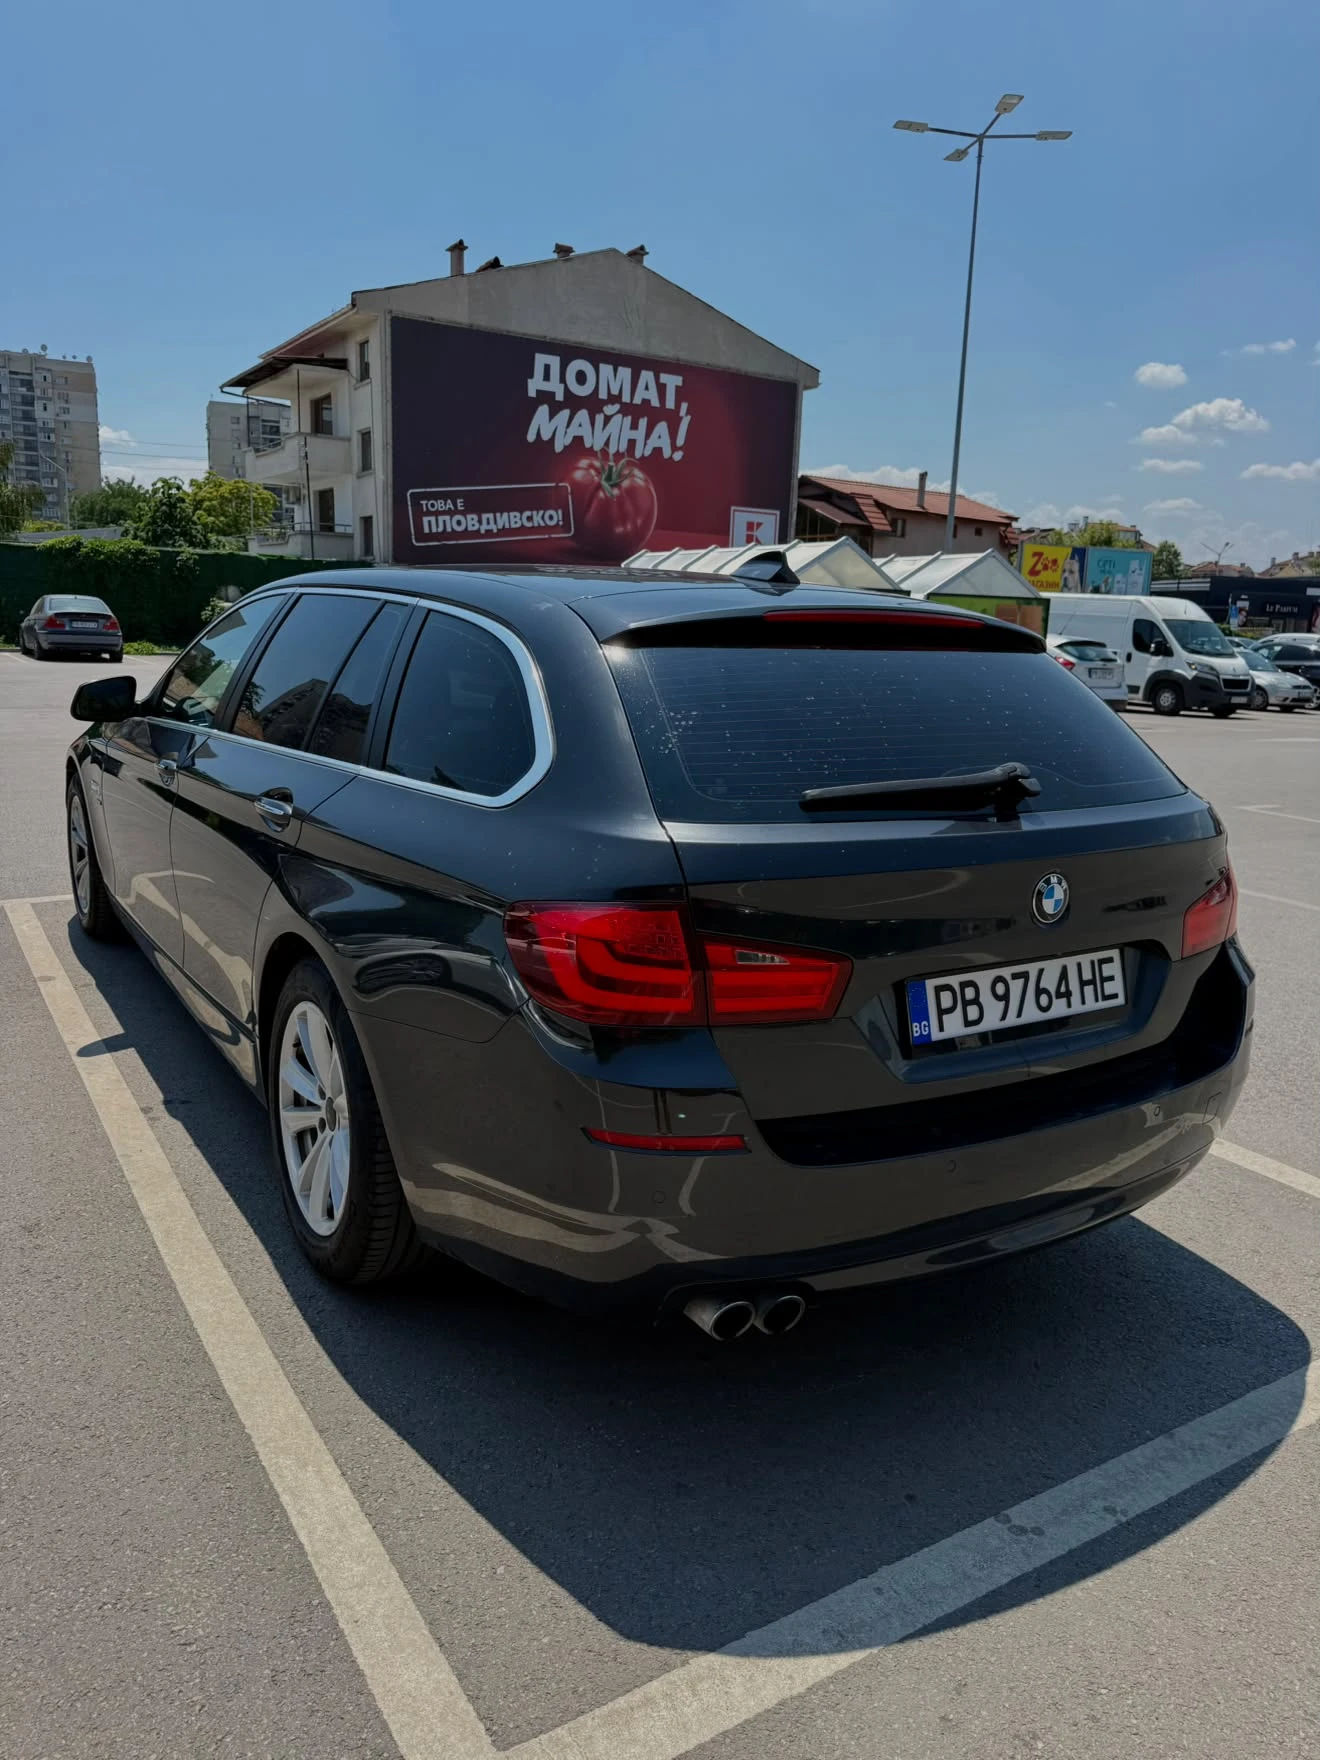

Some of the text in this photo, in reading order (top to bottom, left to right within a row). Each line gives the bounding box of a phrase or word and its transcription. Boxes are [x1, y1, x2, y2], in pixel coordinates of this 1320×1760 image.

[527, 352, 689, 417] ДОМАТ,
[526, 403, 691, 462] МАЙНА!
[420, 498, 465, 512] ТОВА Е
[422, 508, 564, 534] ПЛОВДИВСКО!
[1028, 579, 1060, 589] АГАЗИН
[1038, 875, 1068, 893] BMW
[933, 956, 1119, 1033] PB 9764 HE
[911, 1020, 930, 1038] BG
